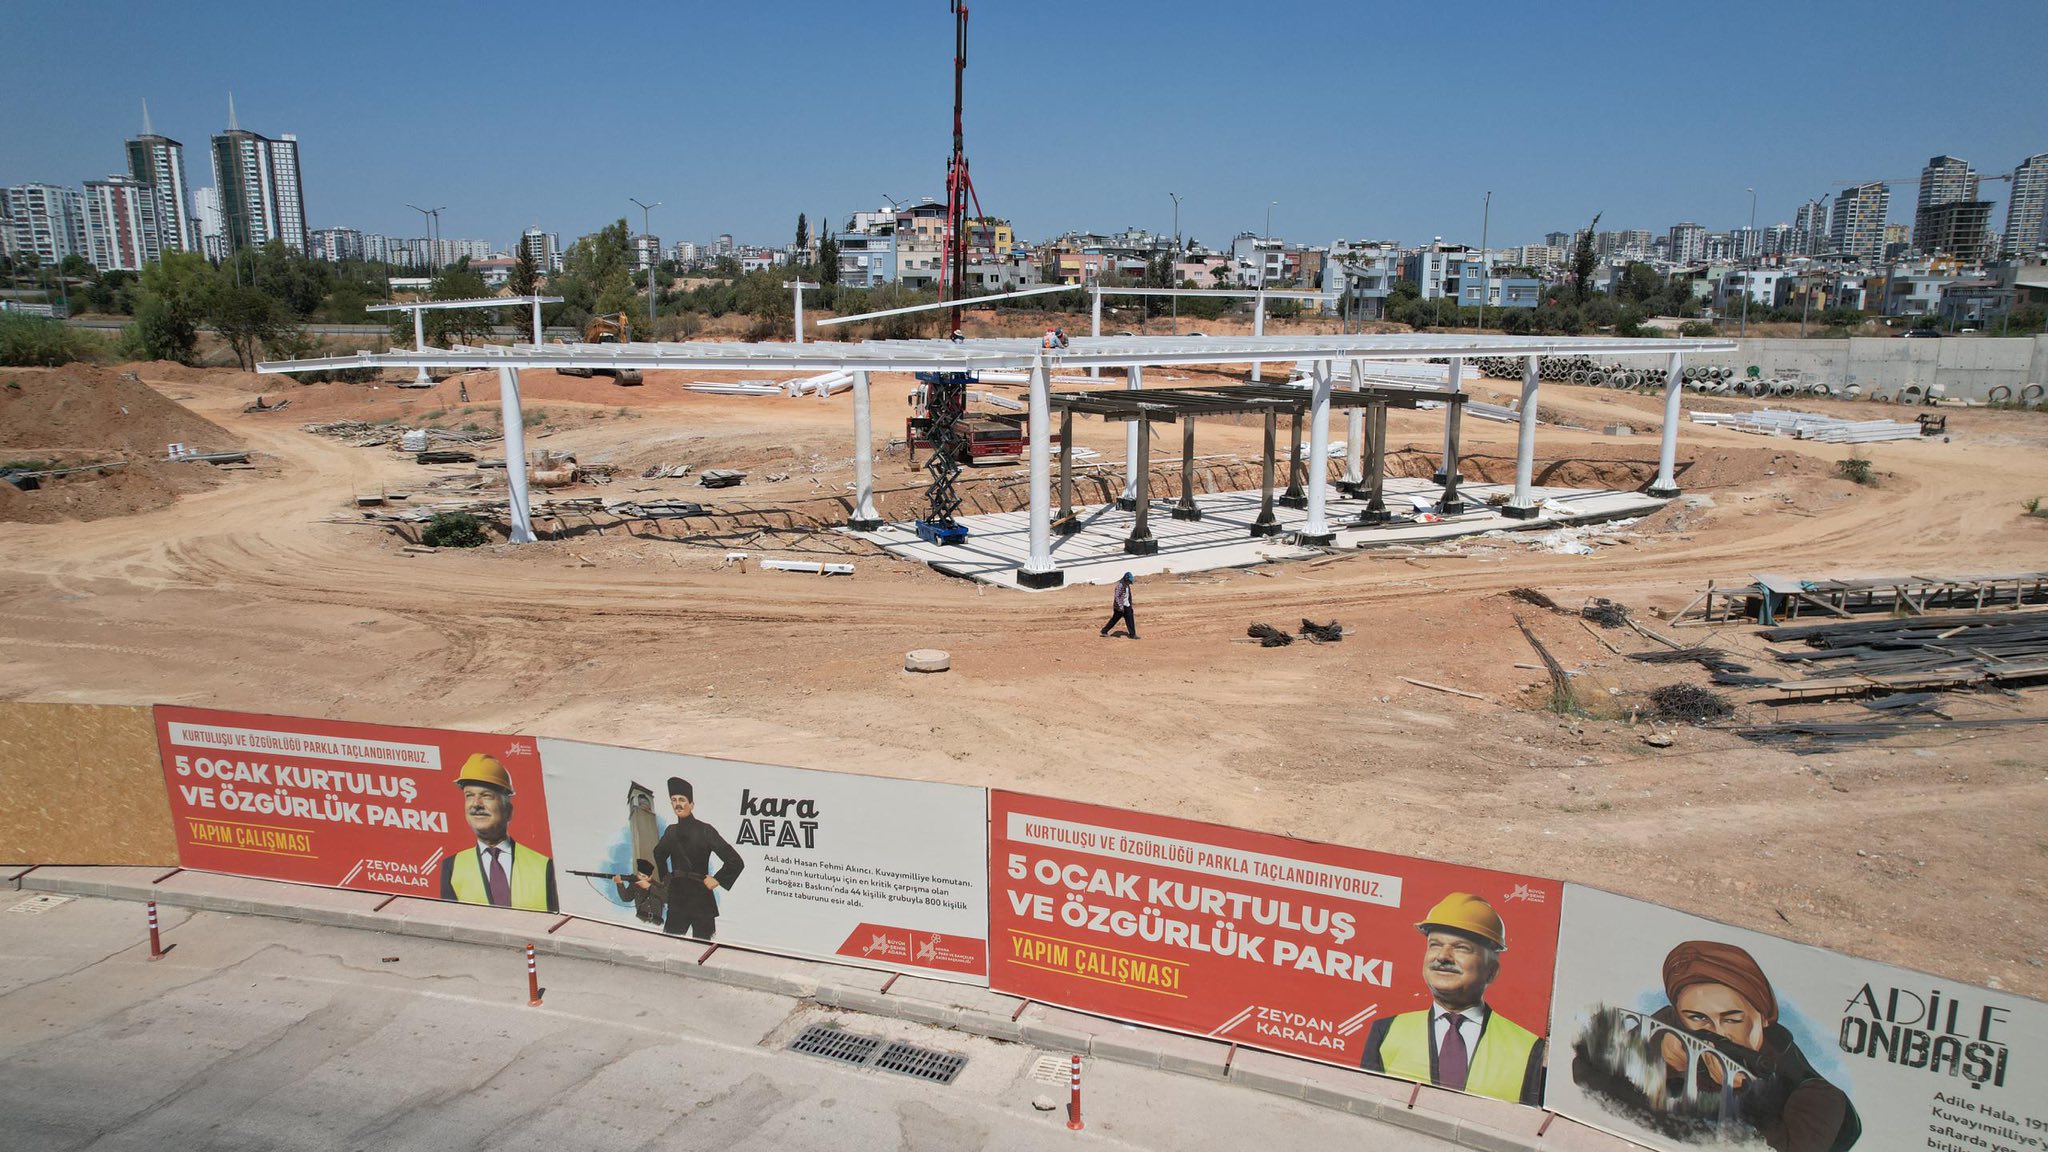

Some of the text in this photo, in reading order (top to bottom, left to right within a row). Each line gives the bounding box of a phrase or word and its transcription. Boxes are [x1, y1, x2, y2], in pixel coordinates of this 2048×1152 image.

[182, 729, 430, 764] KURTULUŞU VE ÖZGÜRLÜĞÜ PARKLA TAÇLANDIRIYORUZ.
[175, 755, 417, 803] 5 OCAK KURTULUŞ
[179, 784, 449, 833] VE ÖZGÜRLÜK PARKI
[740, 788, 820, 819] kara
[189, 822, 311, 853] YAPIM ÇALIŞMASI
[736, 818, 818, 849] AFAT
[366, 859, 418, 874] ZEYDAN
[764, 854, 779, 863] Asıl
[794, 858, 818, 868] Hasan
[819, 861, 844, 871] Fehmi
[875, 868, 930, 883] Kuvayımilliye
[931, 875, 973, 888] komutanı.
[1025, 823, 1383, 898] KURTULUŞU VE ÖZGÜRLÜĞÜ PARKLA TAÇLANDIRIYORUZ.
[367, 871, 429, 888] KARALAR
[764, 865, 803, 877] Adana'nın
[804, 870, 841, 883] kurtuluşu
[842, 875, 858, 885] için
[870, 879, 892, 889] kritik
[893, 883, 930, 894] çarpışma
[931, 887, 949, 896] olan
[765, 876, 803, 888] Karboğazı
[850, 888, 861, 896] 44
[862, 889, 887, 900] kişilik
[888, 894, 923, 905] grubuyla
[924, 897, 941, 907] 800
[942, 901, 968, 910] kişilik
[766, 887, 864, 908] Fransız taburunu esir aldı.
[1008, 853, 1357, 943] 5 OCAK KURTULUŞ
[1007, 889, 1393, 988] VE ÖZGÜRLÜK PARKI
[1011, 935, 1069, 968] YAPIM
[1075, 950, 1180, 989] ÇALIŞMASI
[1257, 1005, 1333, 1034] ZEYDAN
[1844, 982, 2011, 1046] ADİLE
[1256, 1020, 1346, 1051] KARALAR
[1839, 1016, 2008, 1090] ONBAŞI
[1934, 1092, 1975, 1111] Adile
[1980, 1104, 2019, 1126] Hala,
[1929, 1124, 1987, 1147] saflarda
